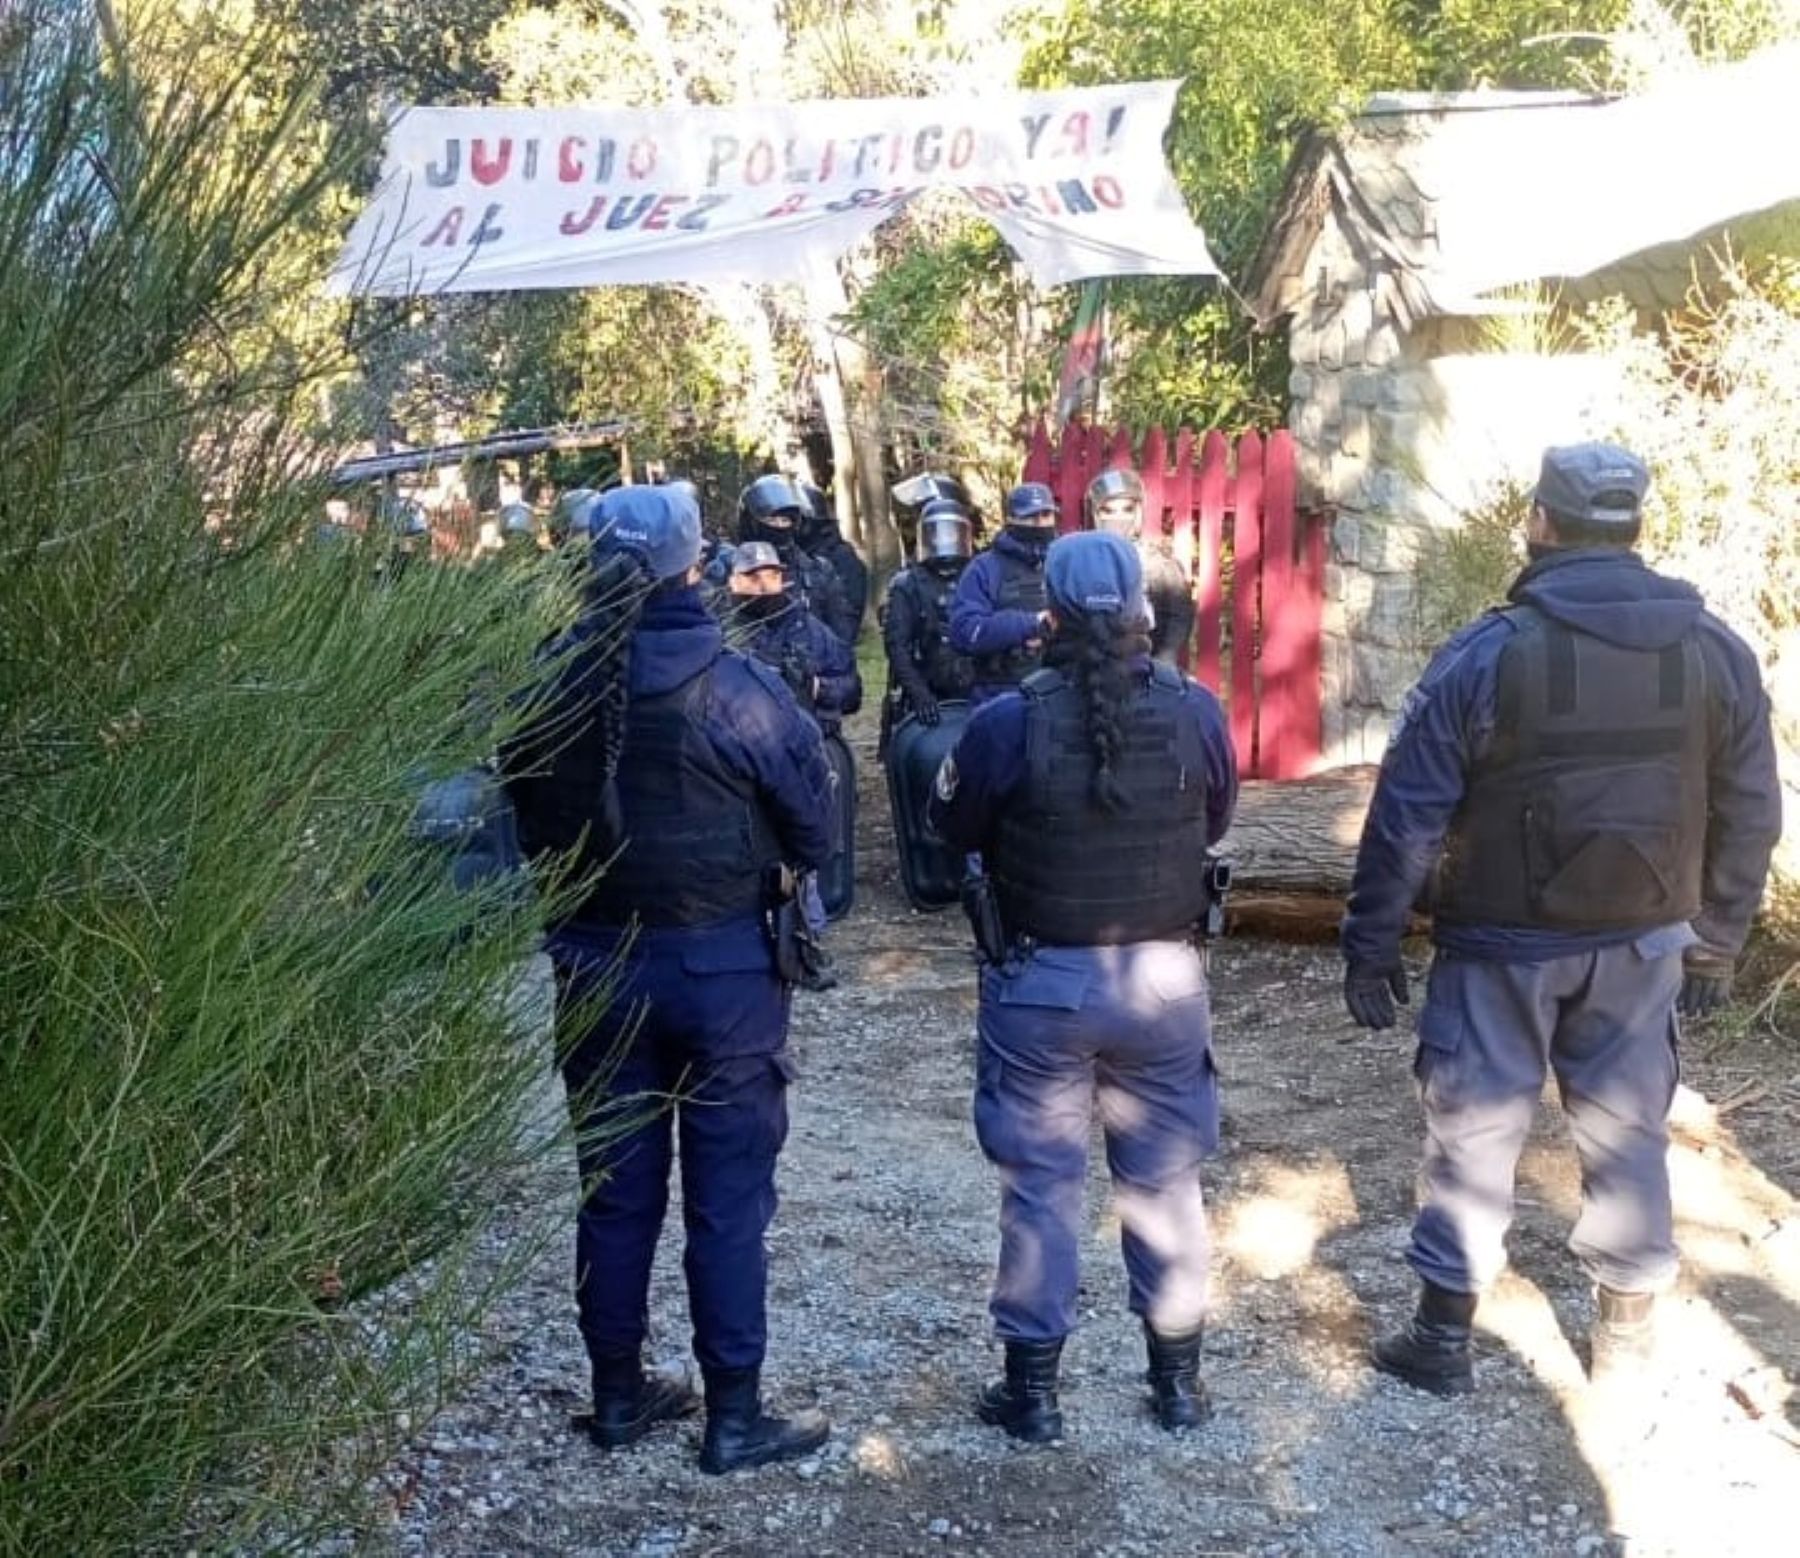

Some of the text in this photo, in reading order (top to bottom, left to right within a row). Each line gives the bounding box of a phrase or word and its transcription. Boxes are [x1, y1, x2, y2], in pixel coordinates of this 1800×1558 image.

[425, 105, 1127, 187] JUICIO POLITICO YA!
[420, 202, 504, 247] AL
[558, 193, 733, 236] JUEZ
